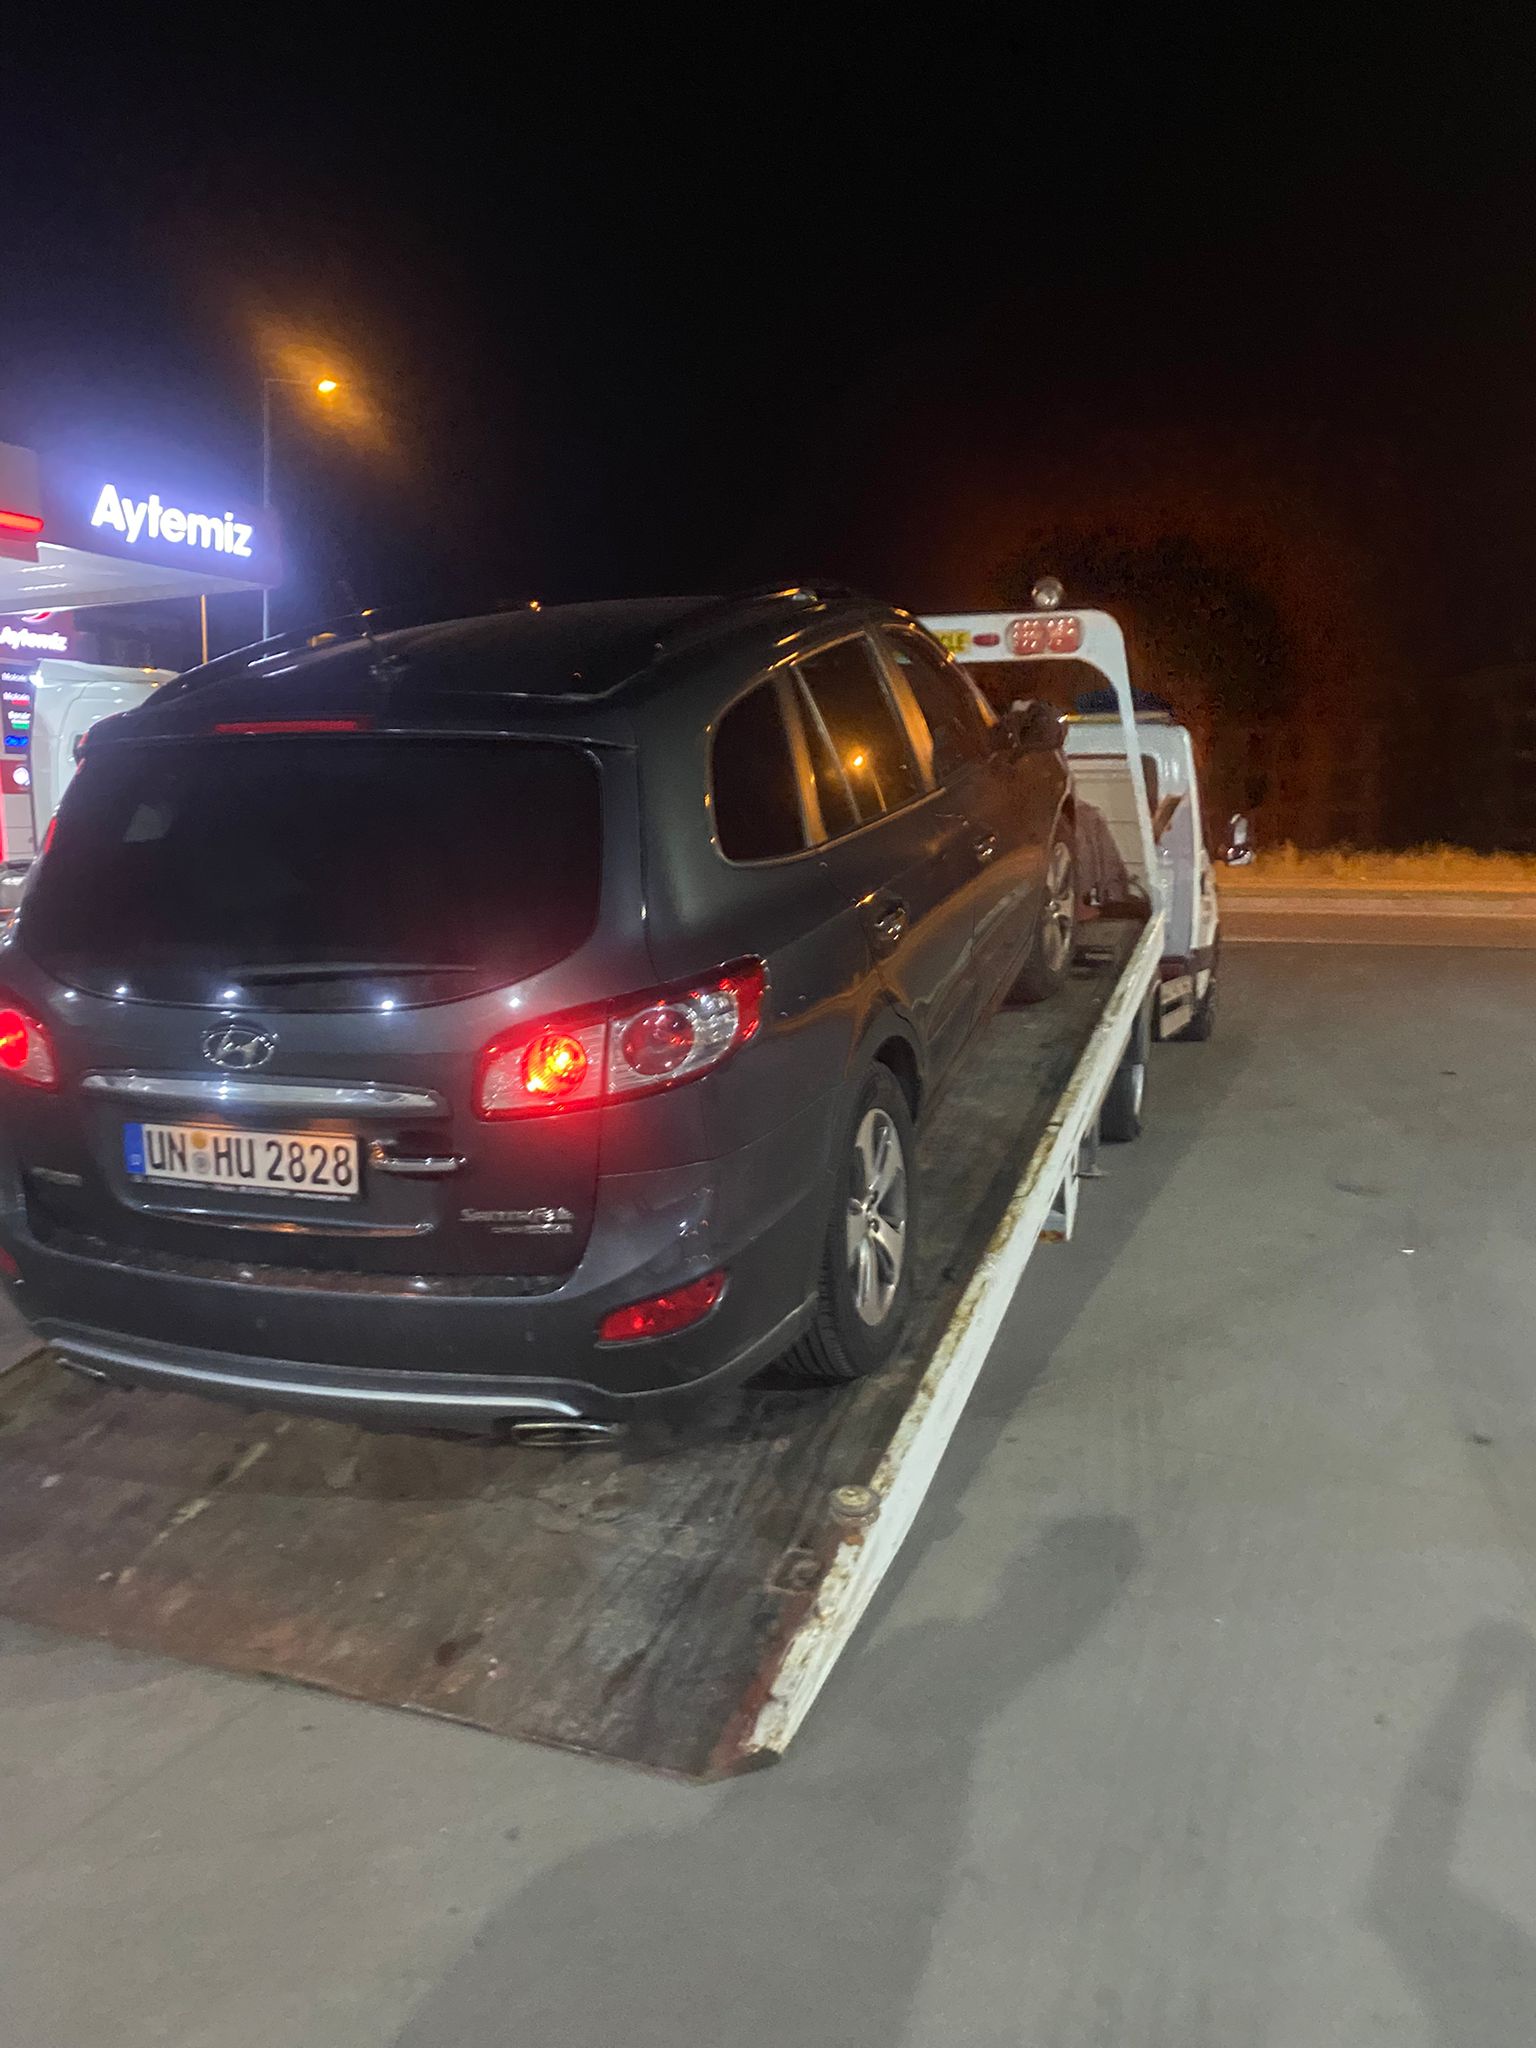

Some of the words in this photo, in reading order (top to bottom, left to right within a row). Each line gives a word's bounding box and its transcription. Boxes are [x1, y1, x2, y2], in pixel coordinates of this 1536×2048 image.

[90, 483, 253, 557] Aytemiz
[146, 1130, 187, 1172] UN
[213, 1136, 256, 1178] HU
[266, 1140, 352, 1187] 2828
